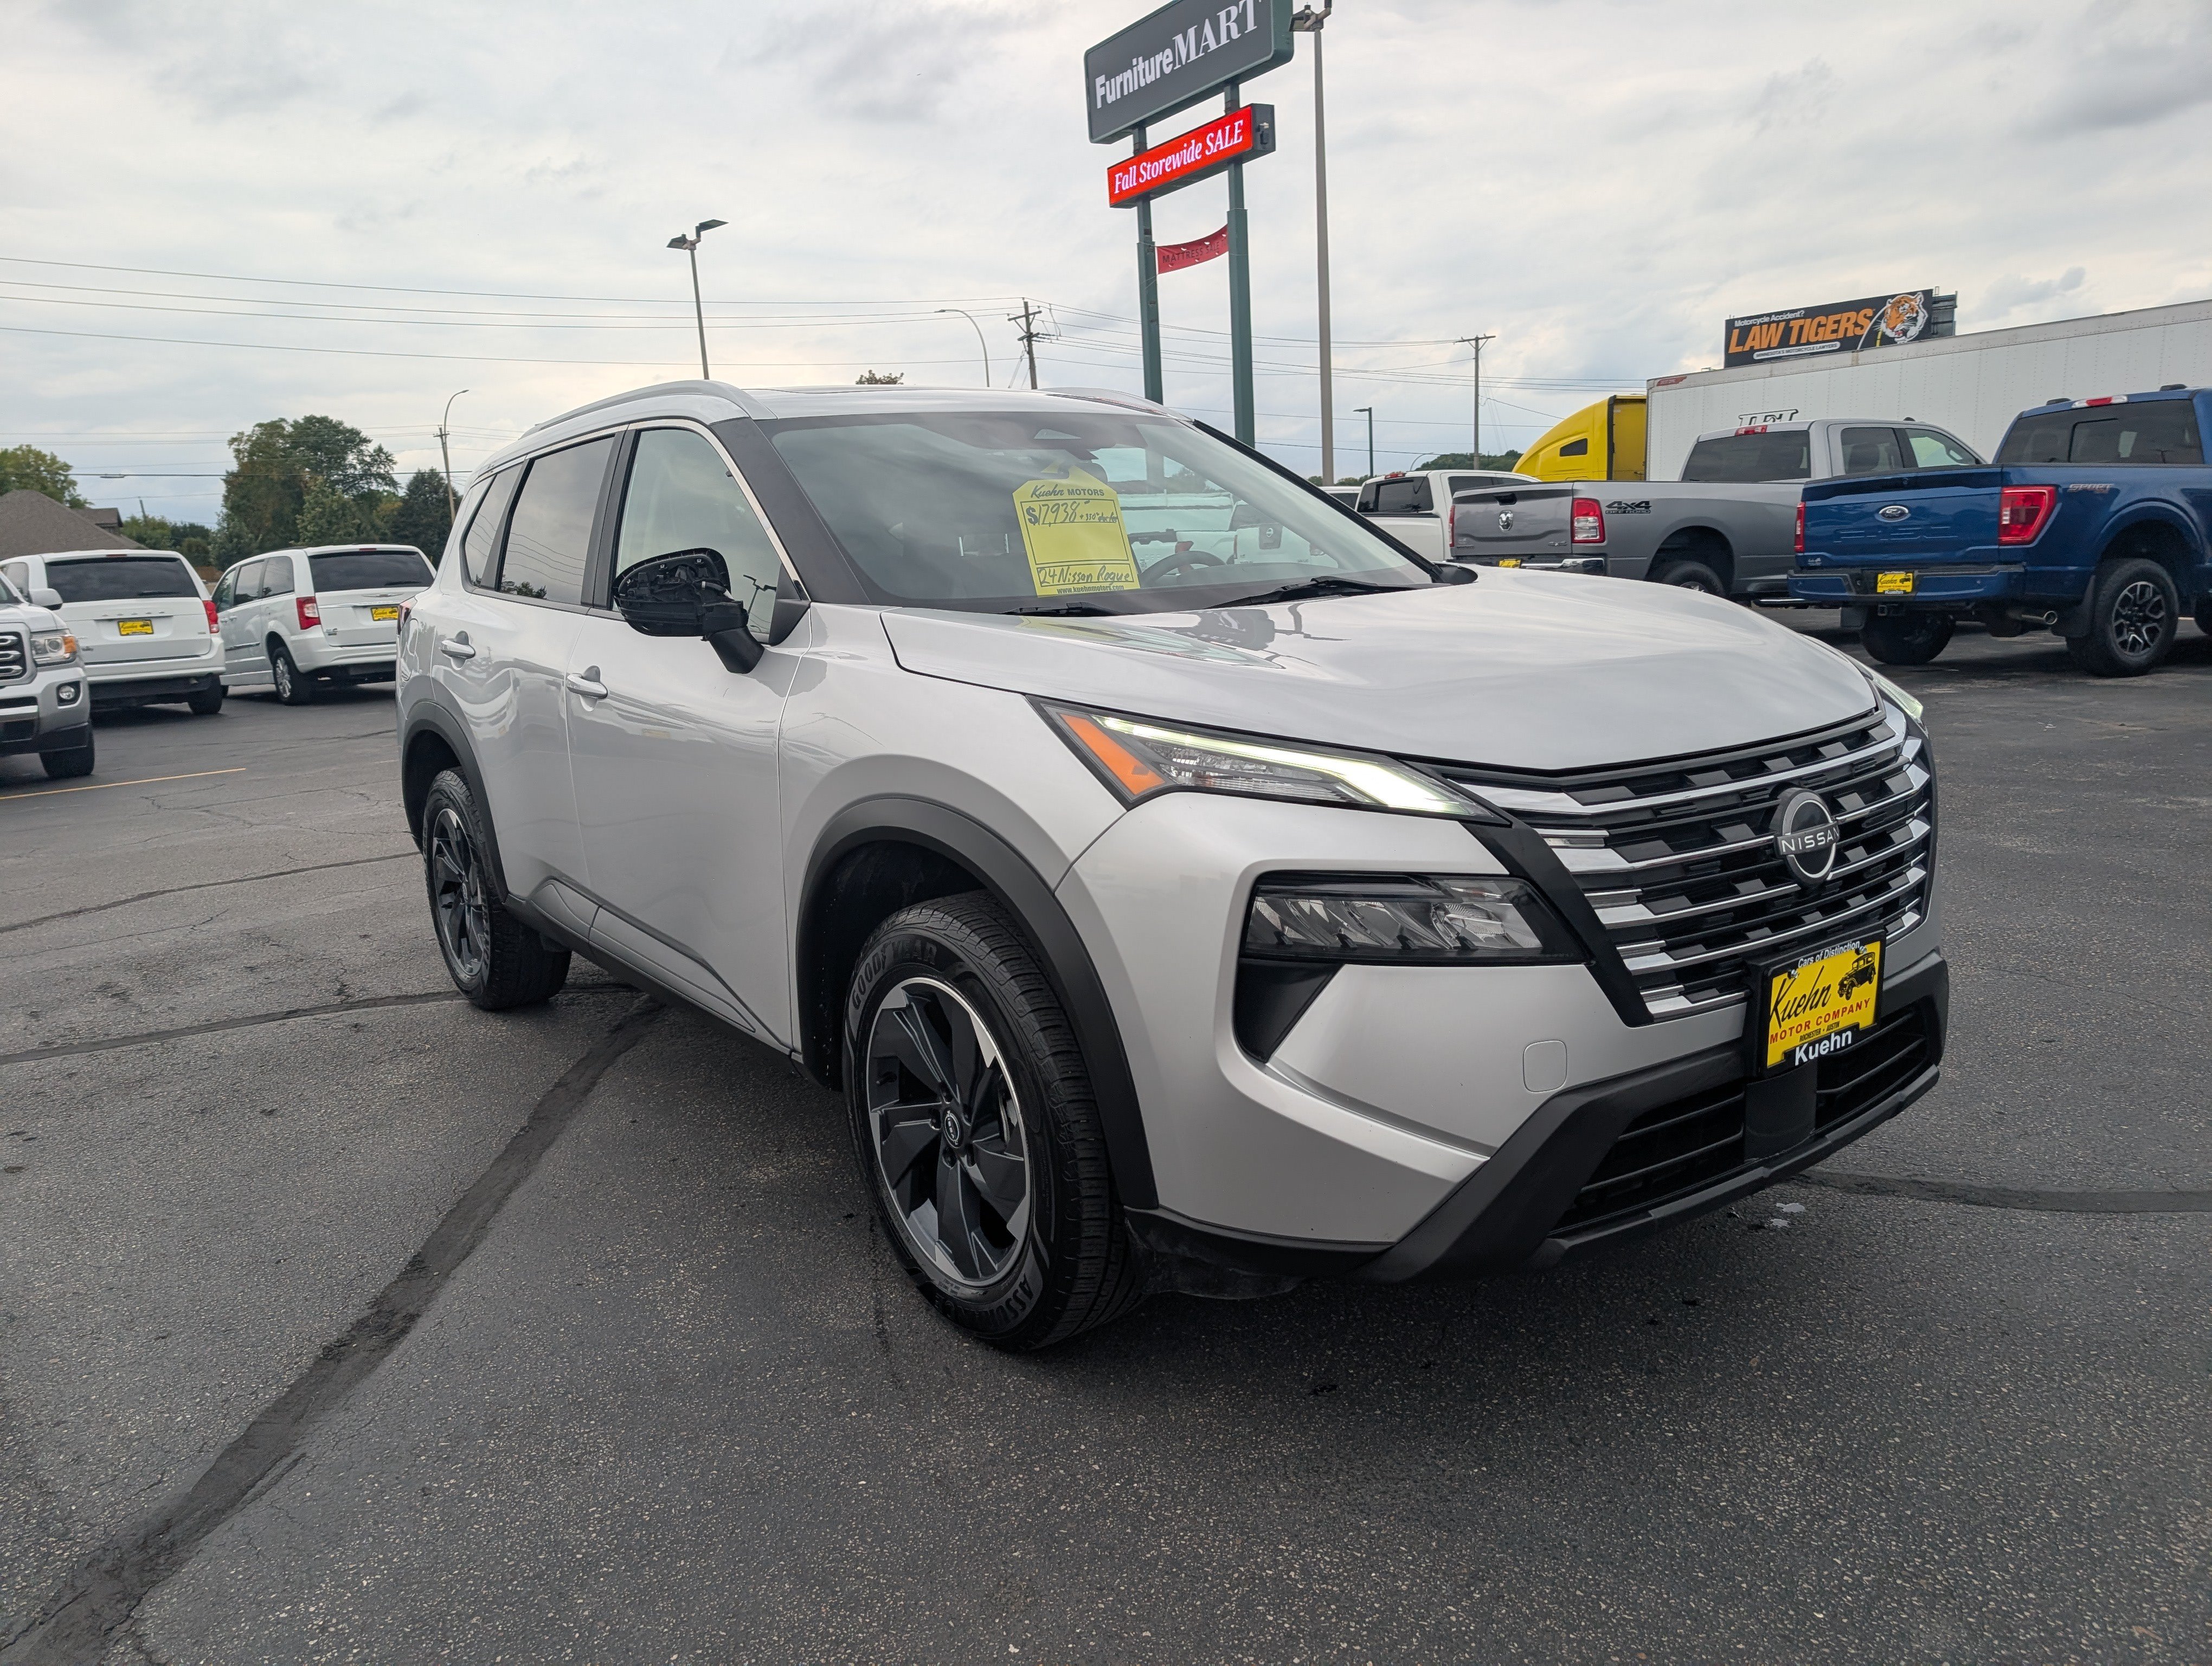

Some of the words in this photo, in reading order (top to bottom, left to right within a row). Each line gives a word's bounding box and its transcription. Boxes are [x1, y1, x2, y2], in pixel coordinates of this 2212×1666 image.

[1095, 0, 1262, 108] FurnitureMART
[1114, 165, 1137, 194] Fall
[1139, 139, 1203, 183] Storewide
[1205, 119, 1244, 156] SALE
[1162, 247, 1203, 263] MATTRESS
[1728, 322, 1786, 353] LAW
[1789, 309, 1874, 345] TIGERS
[1734, 316, 1770, 326] Motorcycle
[1771, 310, 1805, 321] Accident?
[1031, 484, 1064, 498] Kuehn
[1068, 488, 1104, 497] MOTORS
[2067, 484, 2114, 492] SPORT
[1039, 568, 1057, 584] 24
[1058, 566, 1092, 584] Nissan
[1097, 565, 1130, 585] Rogue
[1057, 585, 1124, 594] www.kuehnmotors.com
[1782, 825, 1840, 854] NISSAN
[1798, 957, 1814, 968] Cars
[1816, 950, 1824, 962] of
[1824, 941, 1860, 959] Distinction
[1770, 965, 1832, 1029] Kuehn
[1770, 1020, 1811, 1045] MOTOR
[1816, 998, 1871, 1026] COMPANY
[1799, 1028, 1822, 1042] ROCHESTER
[1795, 1030, 1852, 1066] Kuehn
